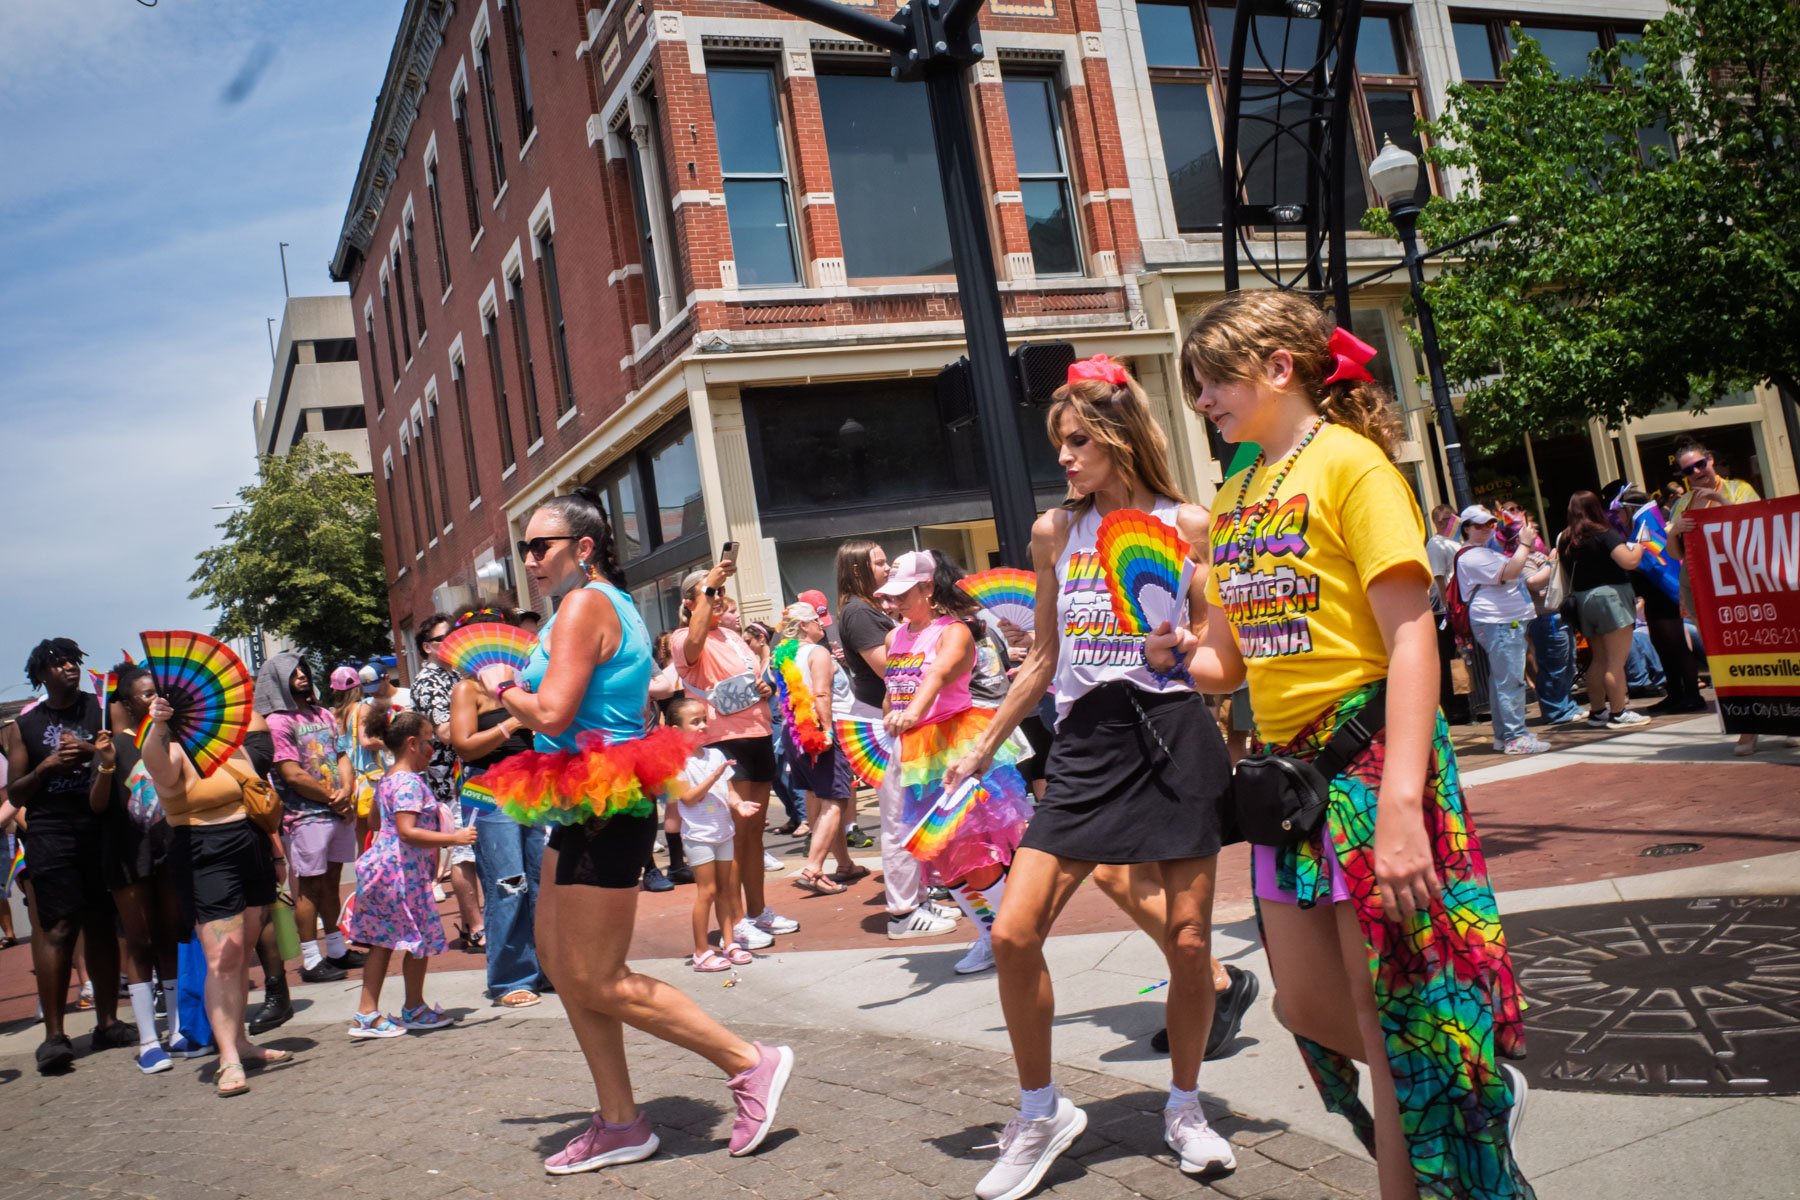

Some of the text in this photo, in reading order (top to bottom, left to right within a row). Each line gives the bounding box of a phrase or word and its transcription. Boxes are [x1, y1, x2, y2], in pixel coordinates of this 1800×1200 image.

[1703, 511, 1800, 597] EVAN
[1722, 627, 1800, 647] 812-426-21
[1729, 659, 1800, 677] evansville
[1724, 703, 1750, 716] Your
[1541, 1058, 1770, 1085] MALL
